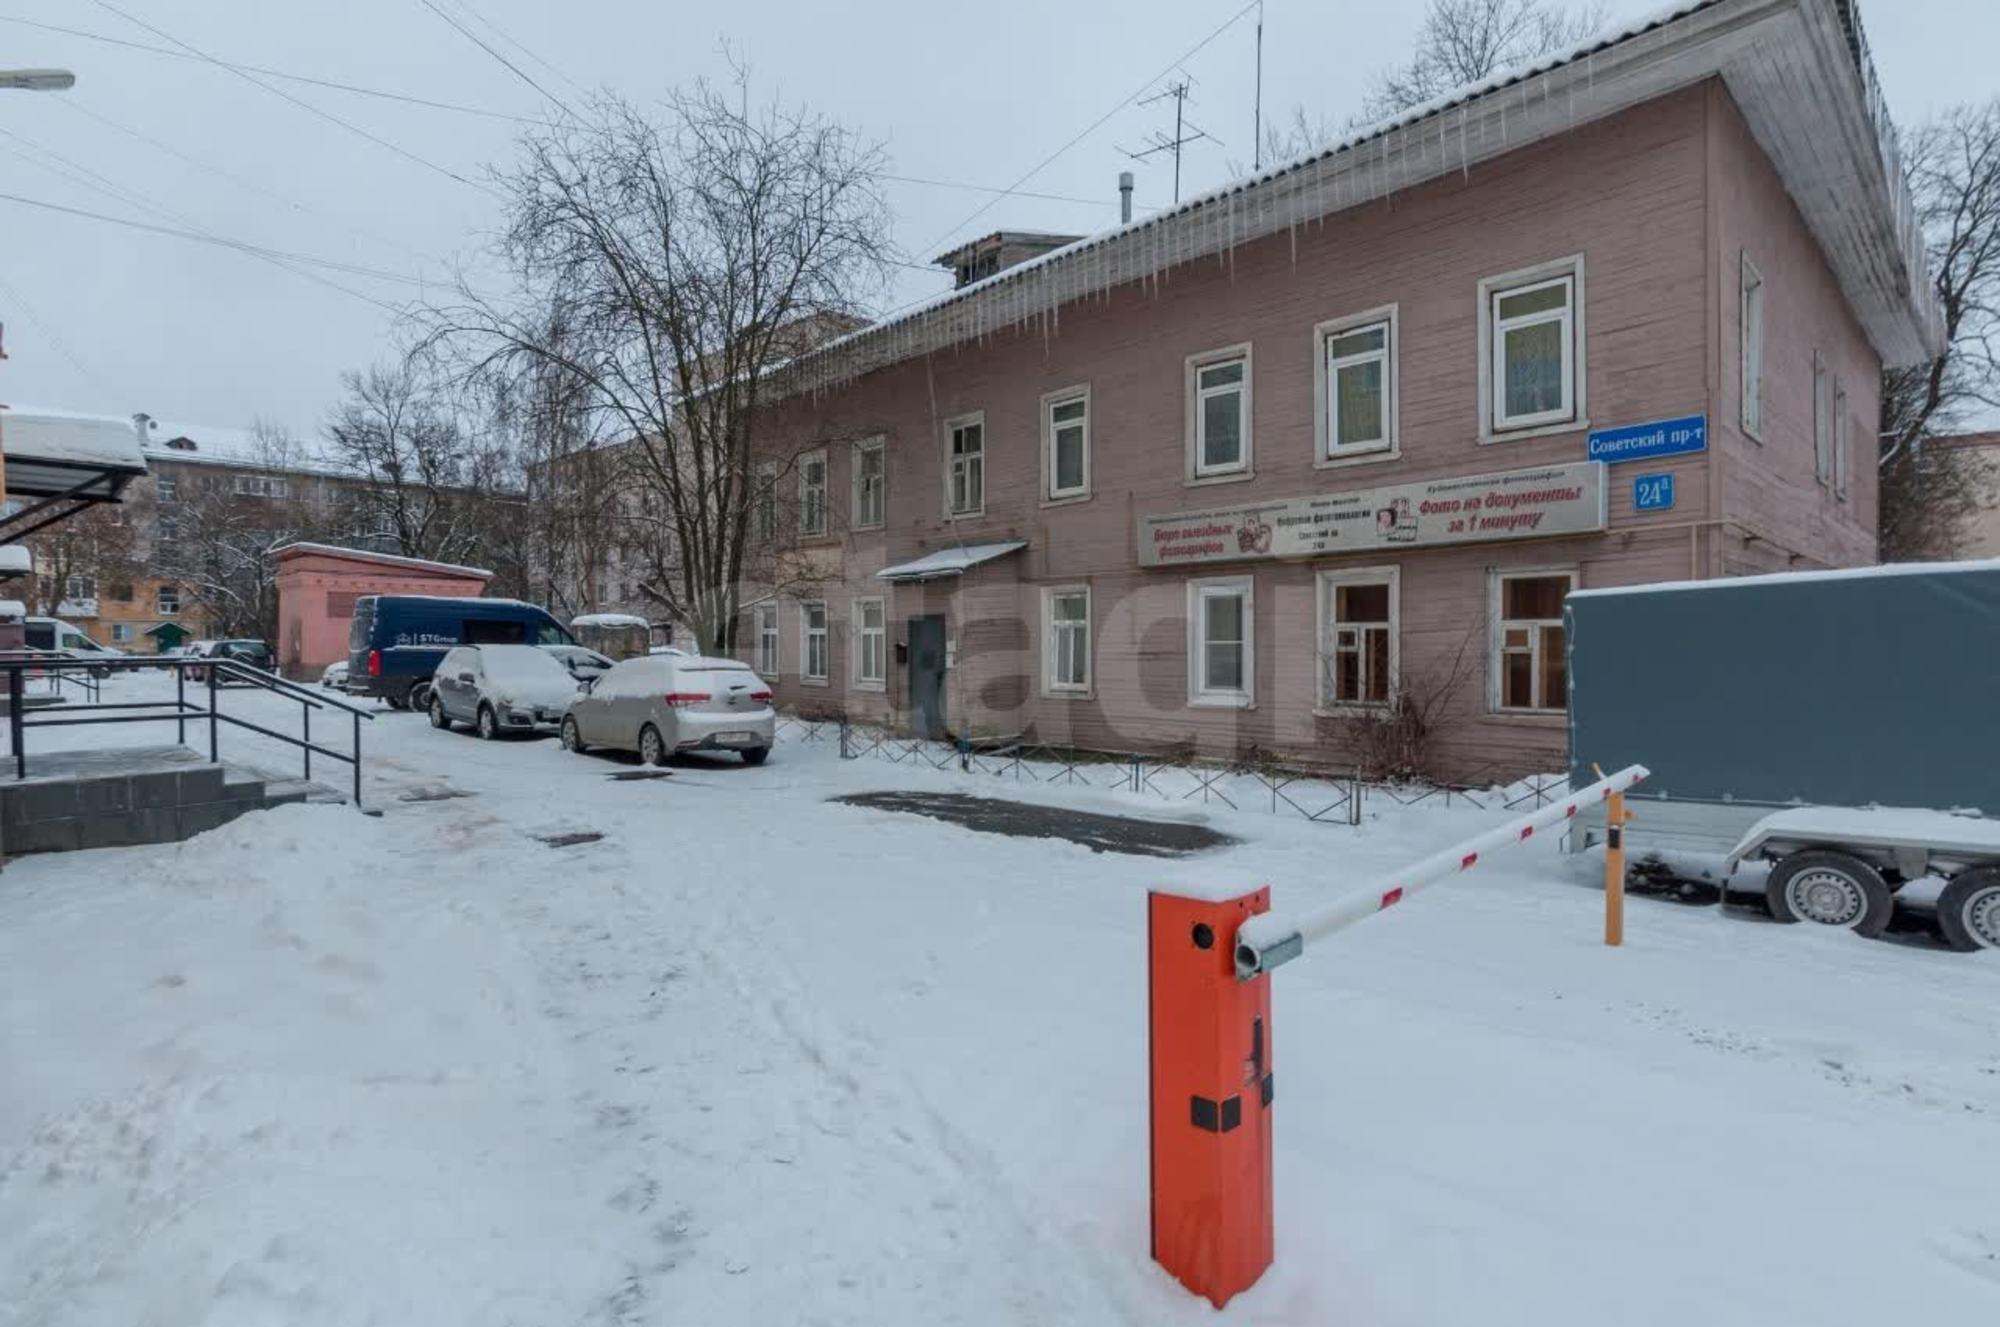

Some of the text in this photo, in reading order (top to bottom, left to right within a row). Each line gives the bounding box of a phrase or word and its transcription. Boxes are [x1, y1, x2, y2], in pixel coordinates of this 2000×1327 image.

[1590, 427, 1703, 454] Советский пр-т
[1419, 485, 1584, 515] Фото на документы
[1447, 511, 1545, 533] за 1 минуту
